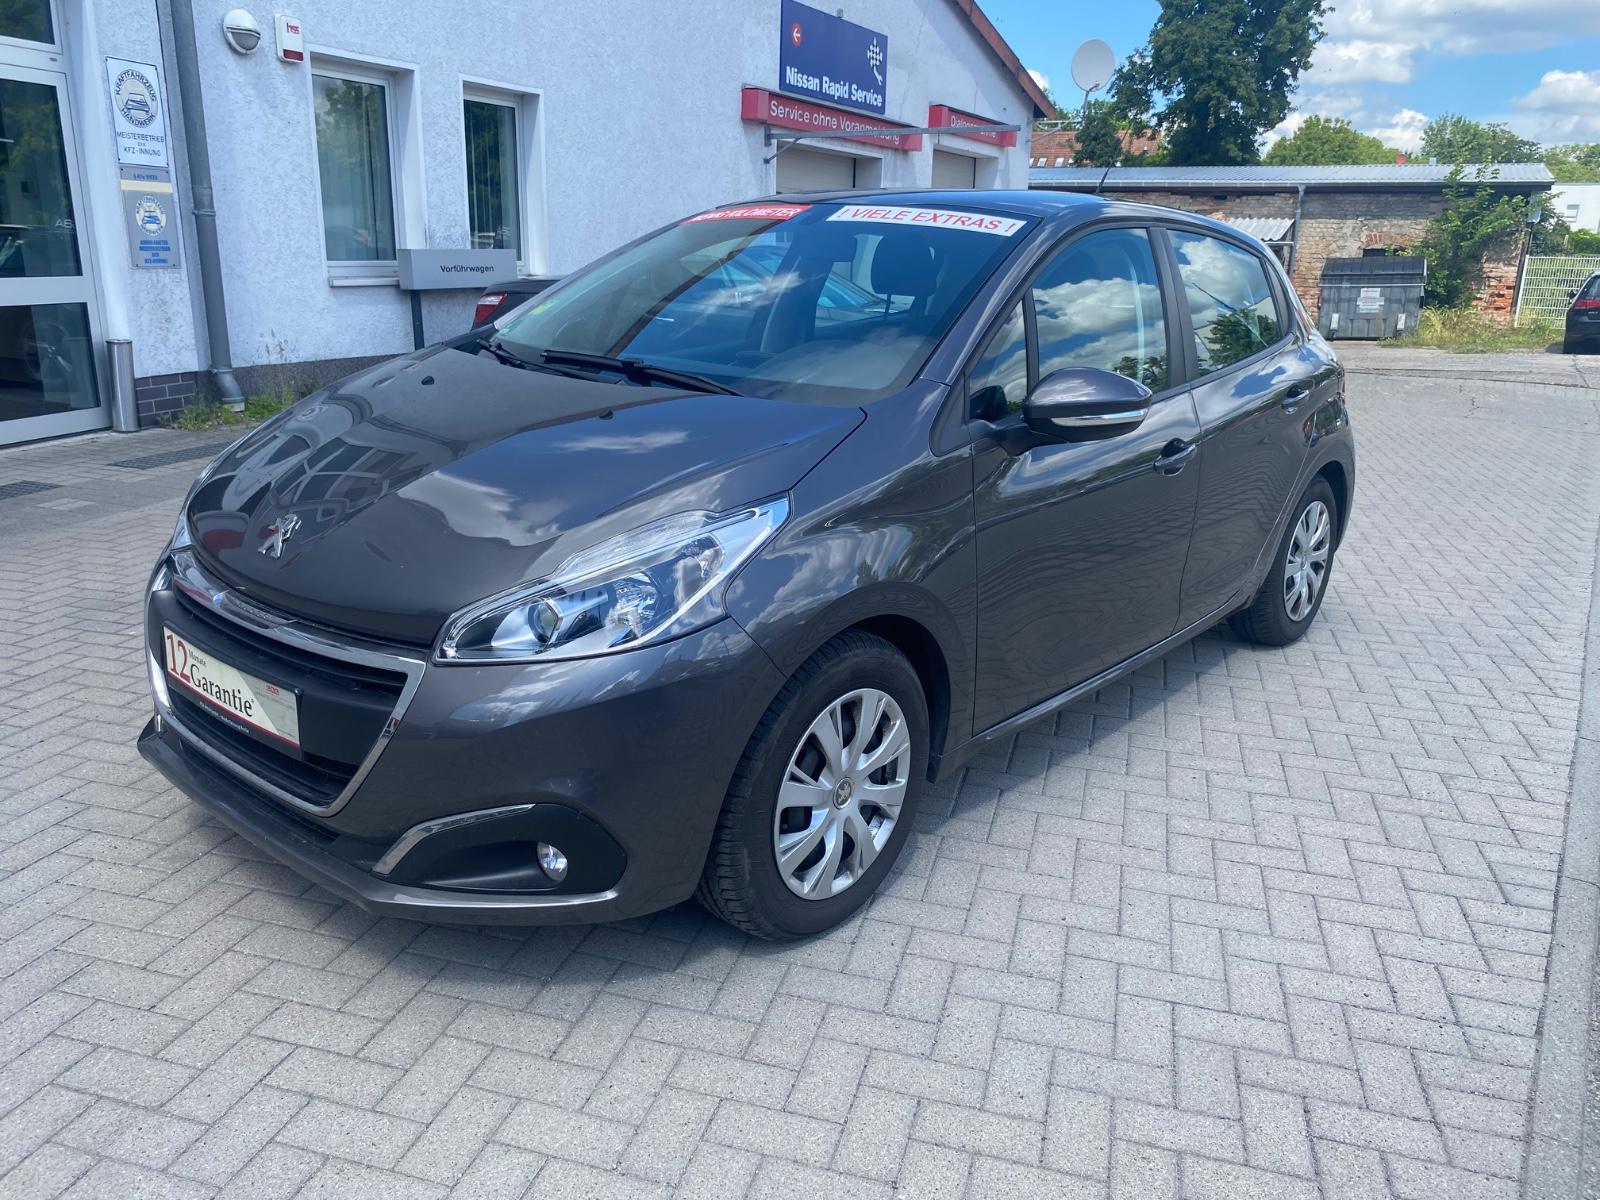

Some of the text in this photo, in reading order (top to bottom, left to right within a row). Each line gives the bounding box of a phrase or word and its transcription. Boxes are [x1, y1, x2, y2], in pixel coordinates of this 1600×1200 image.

[114, 69, 158, 102] KRAFTFAHRZEUG
[786, 66, 883, 107] Nissan Rapid Service
[121, 107, 157, 128] HANDWERK
[770, 100, 810, 123] Service
[812, 111, 838, 129] ohne
[116, 131, 165, 143] MEISTERBETRIEB
[123, 146, 161, 156] KFZ-INNUNG
[851, 208, 912, 220] VIELE
[912, 212, 1002, 230] EXTRAS
[440, 265, 495, 274] Vorführwagen
[167, 634, 191, 684] 12
